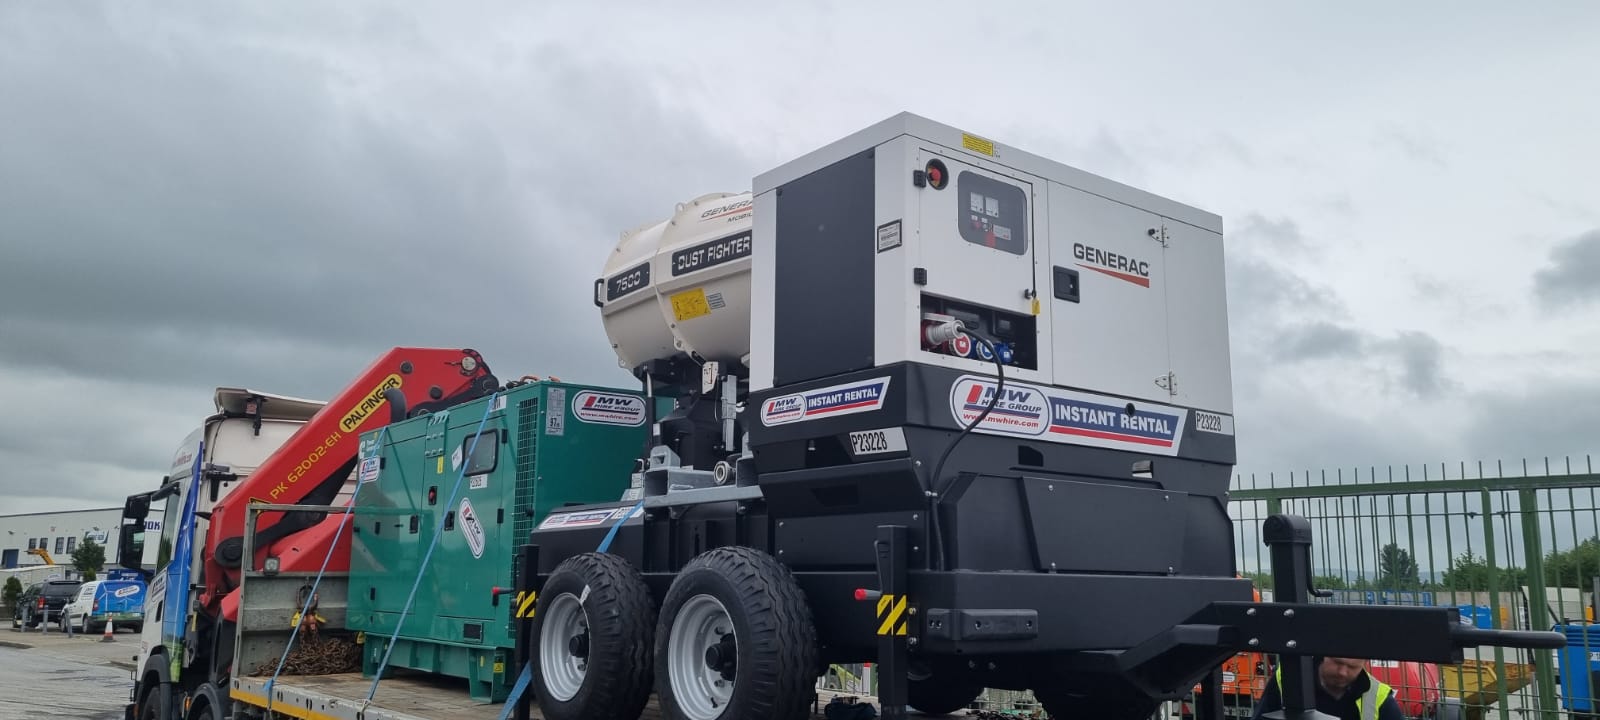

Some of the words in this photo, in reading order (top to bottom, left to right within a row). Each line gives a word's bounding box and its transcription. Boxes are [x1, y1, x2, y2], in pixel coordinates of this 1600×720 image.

[677, 250, 704, 270] DUST
[707, 236, 750, 262] FIGHTER
[1073, 242, 1149, 277] GENERAC
[616, 271, 641, 293] 7500
[808, 393, 843, 408] INSTANT
[844, 388, 879, 401] RENTAL
[981, 399, 1006, 408] HRE
[1008, 402, 1042, 413] GROUP
[1055, 404, 1116, 427] INSTANT
[1120, 413, 1172, 435] RENTAL
[1196, 412, 1222, 432] P23228
[851, 431, 888, 452] P23228
[270, 482, 288, 499] PK
